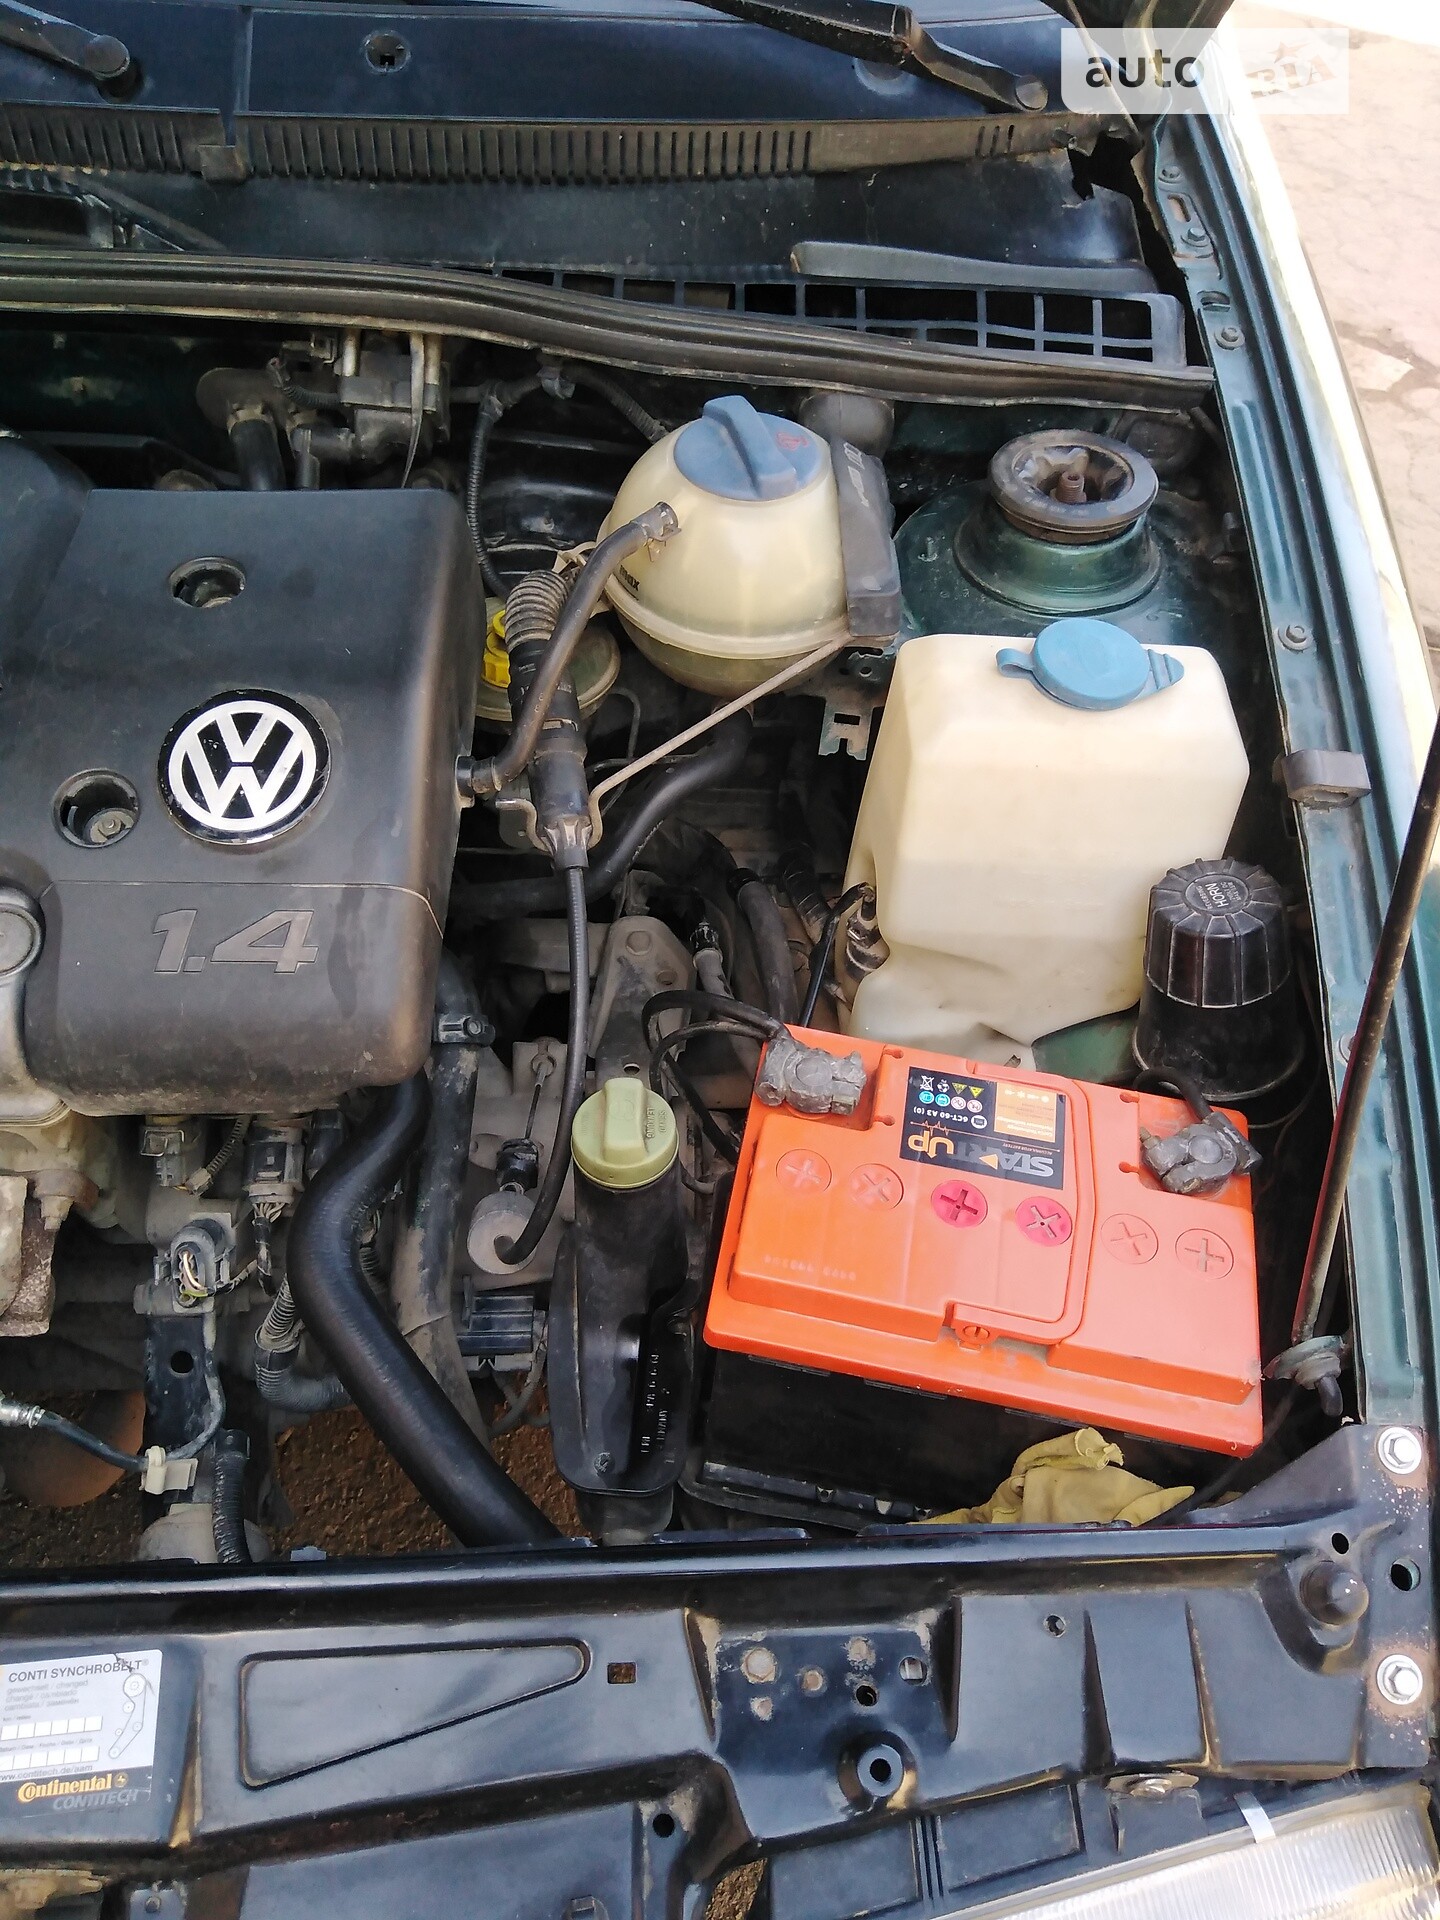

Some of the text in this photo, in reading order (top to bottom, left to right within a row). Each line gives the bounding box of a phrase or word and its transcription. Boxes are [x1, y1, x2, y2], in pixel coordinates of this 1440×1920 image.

[1205, 882, 1229, 908] HORN
[152, 908, 320, 974] 1.4
[8, 1669, 48, 1683] CONTI
[18, 1773, 113, 1803] Continental
[52, 1788, 139, 1811] CONTITECH
